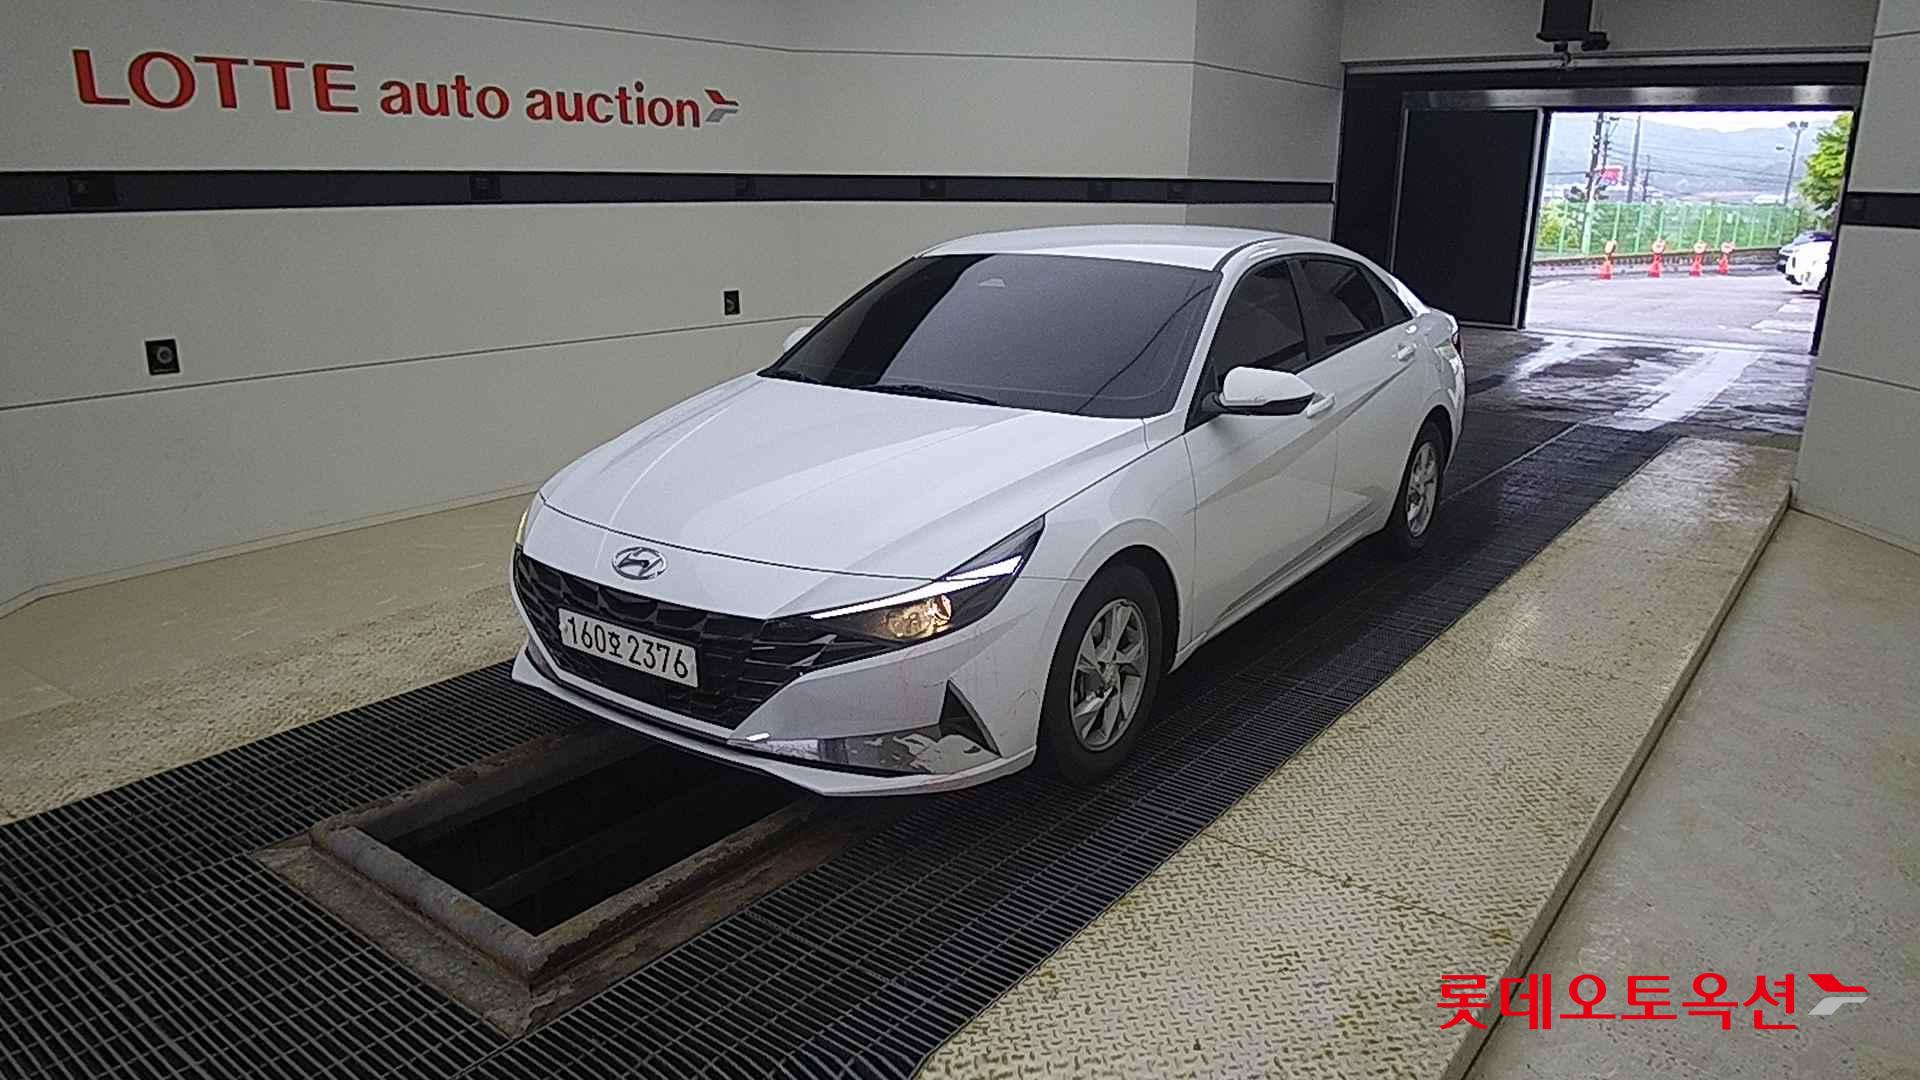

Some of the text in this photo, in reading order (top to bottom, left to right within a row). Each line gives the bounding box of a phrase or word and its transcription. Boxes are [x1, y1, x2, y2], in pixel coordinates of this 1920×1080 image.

[73, 48, 702, 129] LOTTE auto auction
